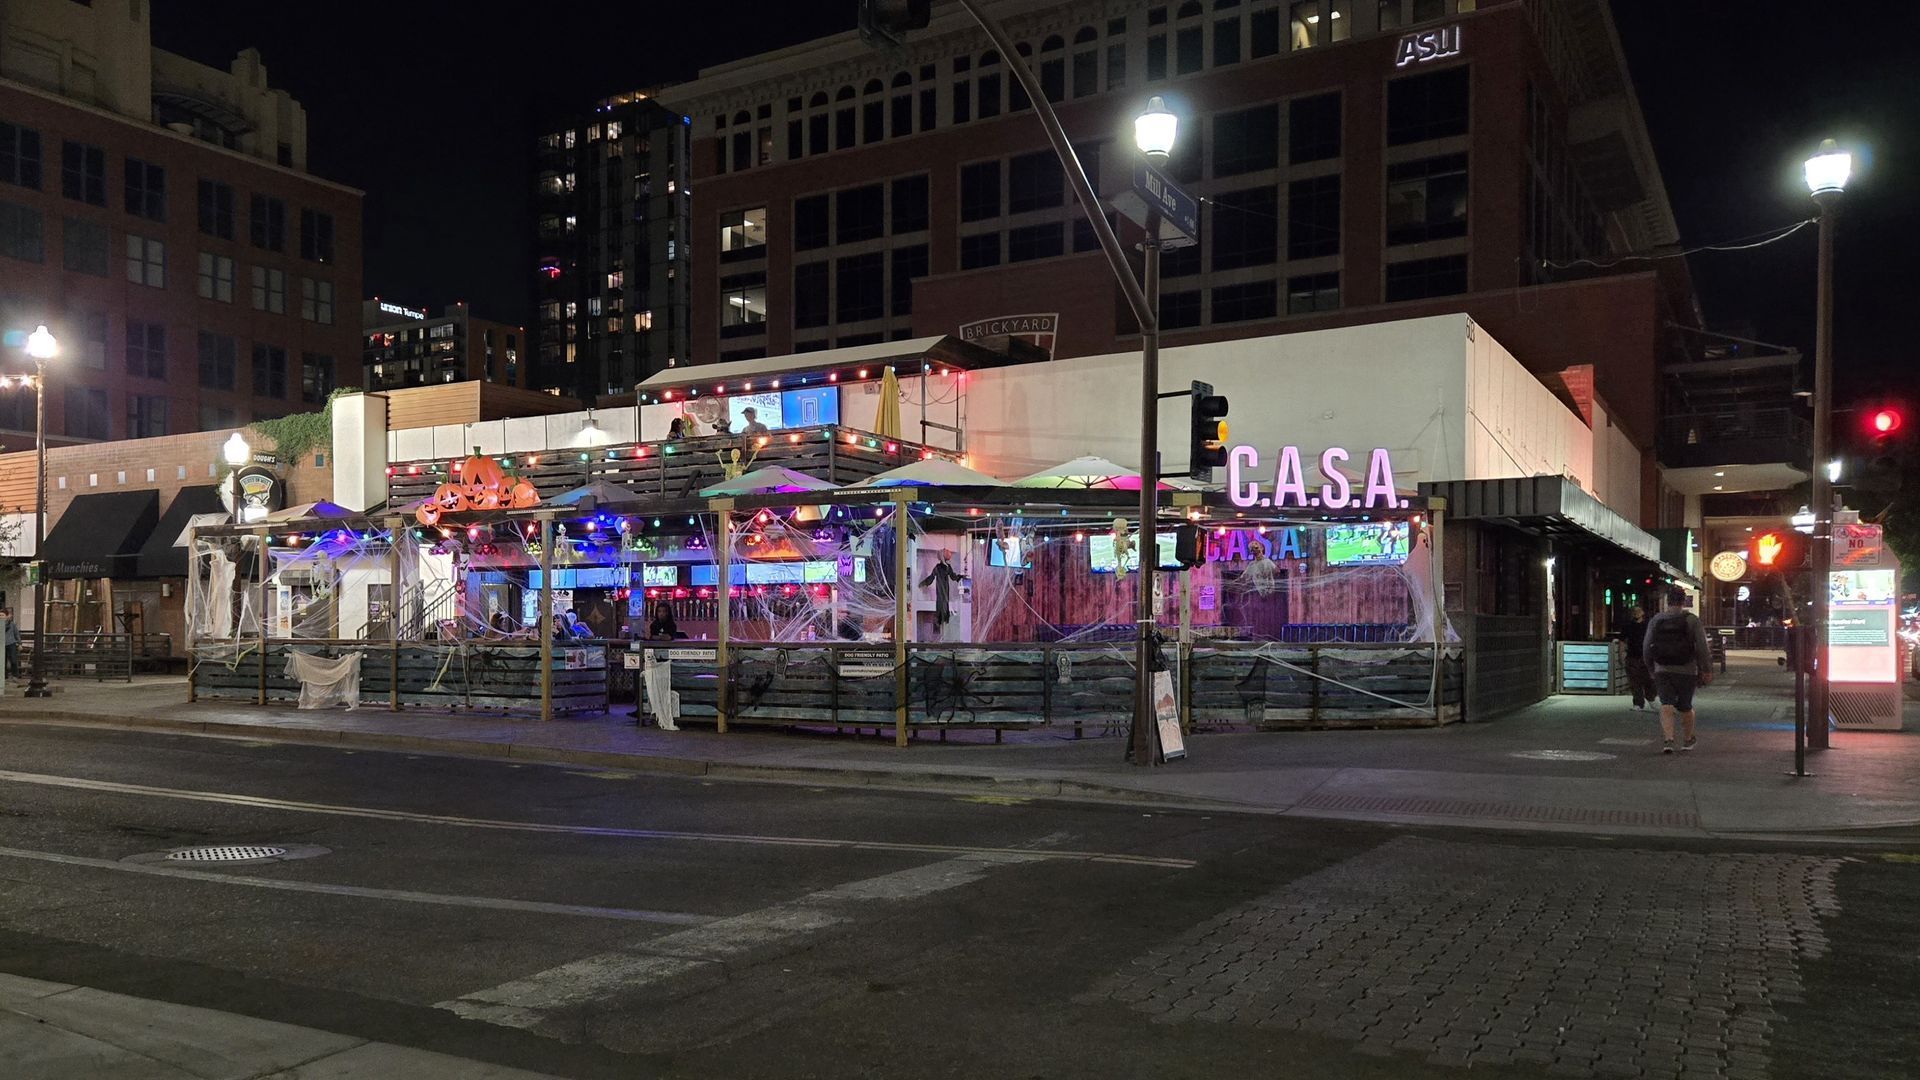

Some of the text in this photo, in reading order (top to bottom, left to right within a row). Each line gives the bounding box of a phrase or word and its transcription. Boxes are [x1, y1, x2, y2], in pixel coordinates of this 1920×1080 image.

[1396, 26, 1460, 67] ASU
[1145, 170, 1161, 199] Mill
[1162, 186, 1177, 212] Ave
[966, 318, 1050, 339] BRICKYARD
[1229, 445, 1410, 509] C.A.S.A.
[1848, 539, 1864, 549] NO
[56, 561, 99, 574] Munchies
